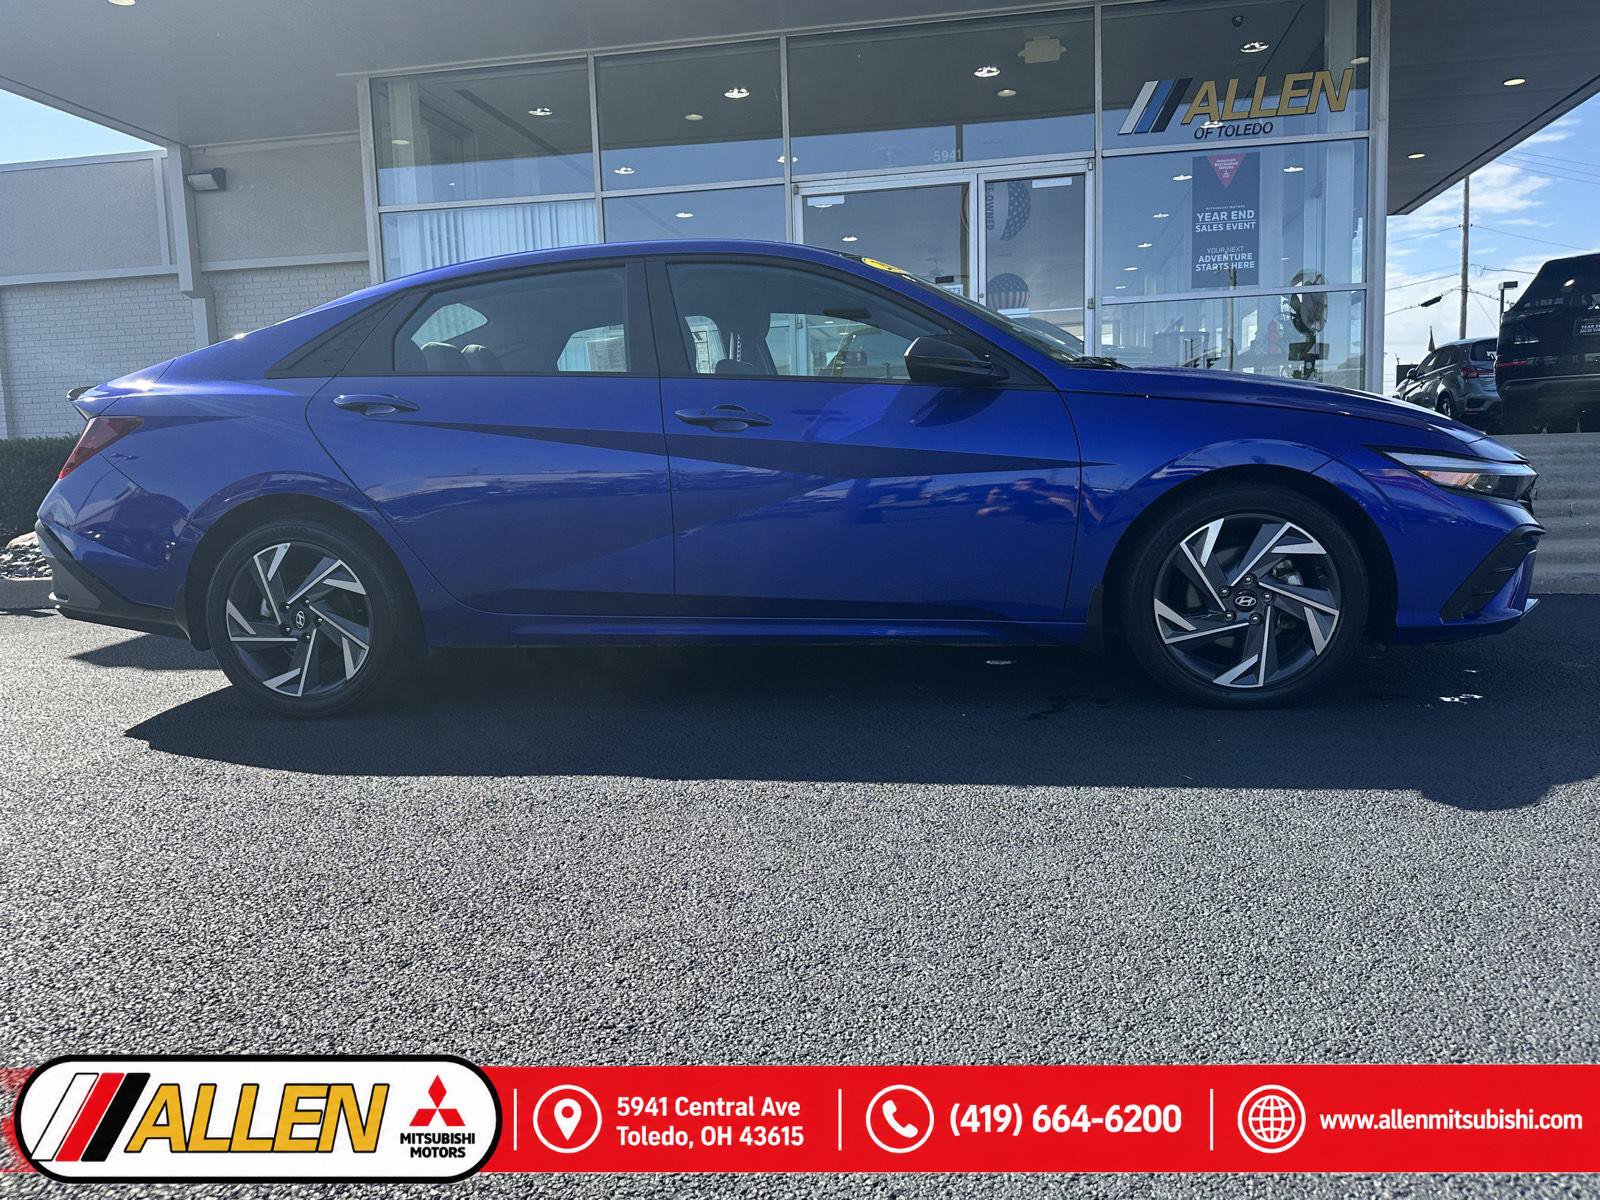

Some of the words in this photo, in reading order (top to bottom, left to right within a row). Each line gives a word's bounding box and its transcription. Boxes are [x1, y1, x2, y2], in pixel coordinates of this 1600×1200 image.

[1181, 68, 1354, 125] ALLEN
[1194, 126, 1212, 140] OF
[1216, 122, 1274, 138] TOLEDO
[934, 149, 961, 162] 5941
[1196, 211, 1228, 222] YEAR
[1231, 209, 1255, 220] END
[1195, 223, 1224, 233] SALES
[1226, 221, 1256, 231] EVENT
[1226, 245, 1244, 253] NEXT
[1198, 252, 1253, 263] ADVENTURE
[1195, 262, 1229, 272] STARTS
[1231, 260, 1255, 270] HERE
